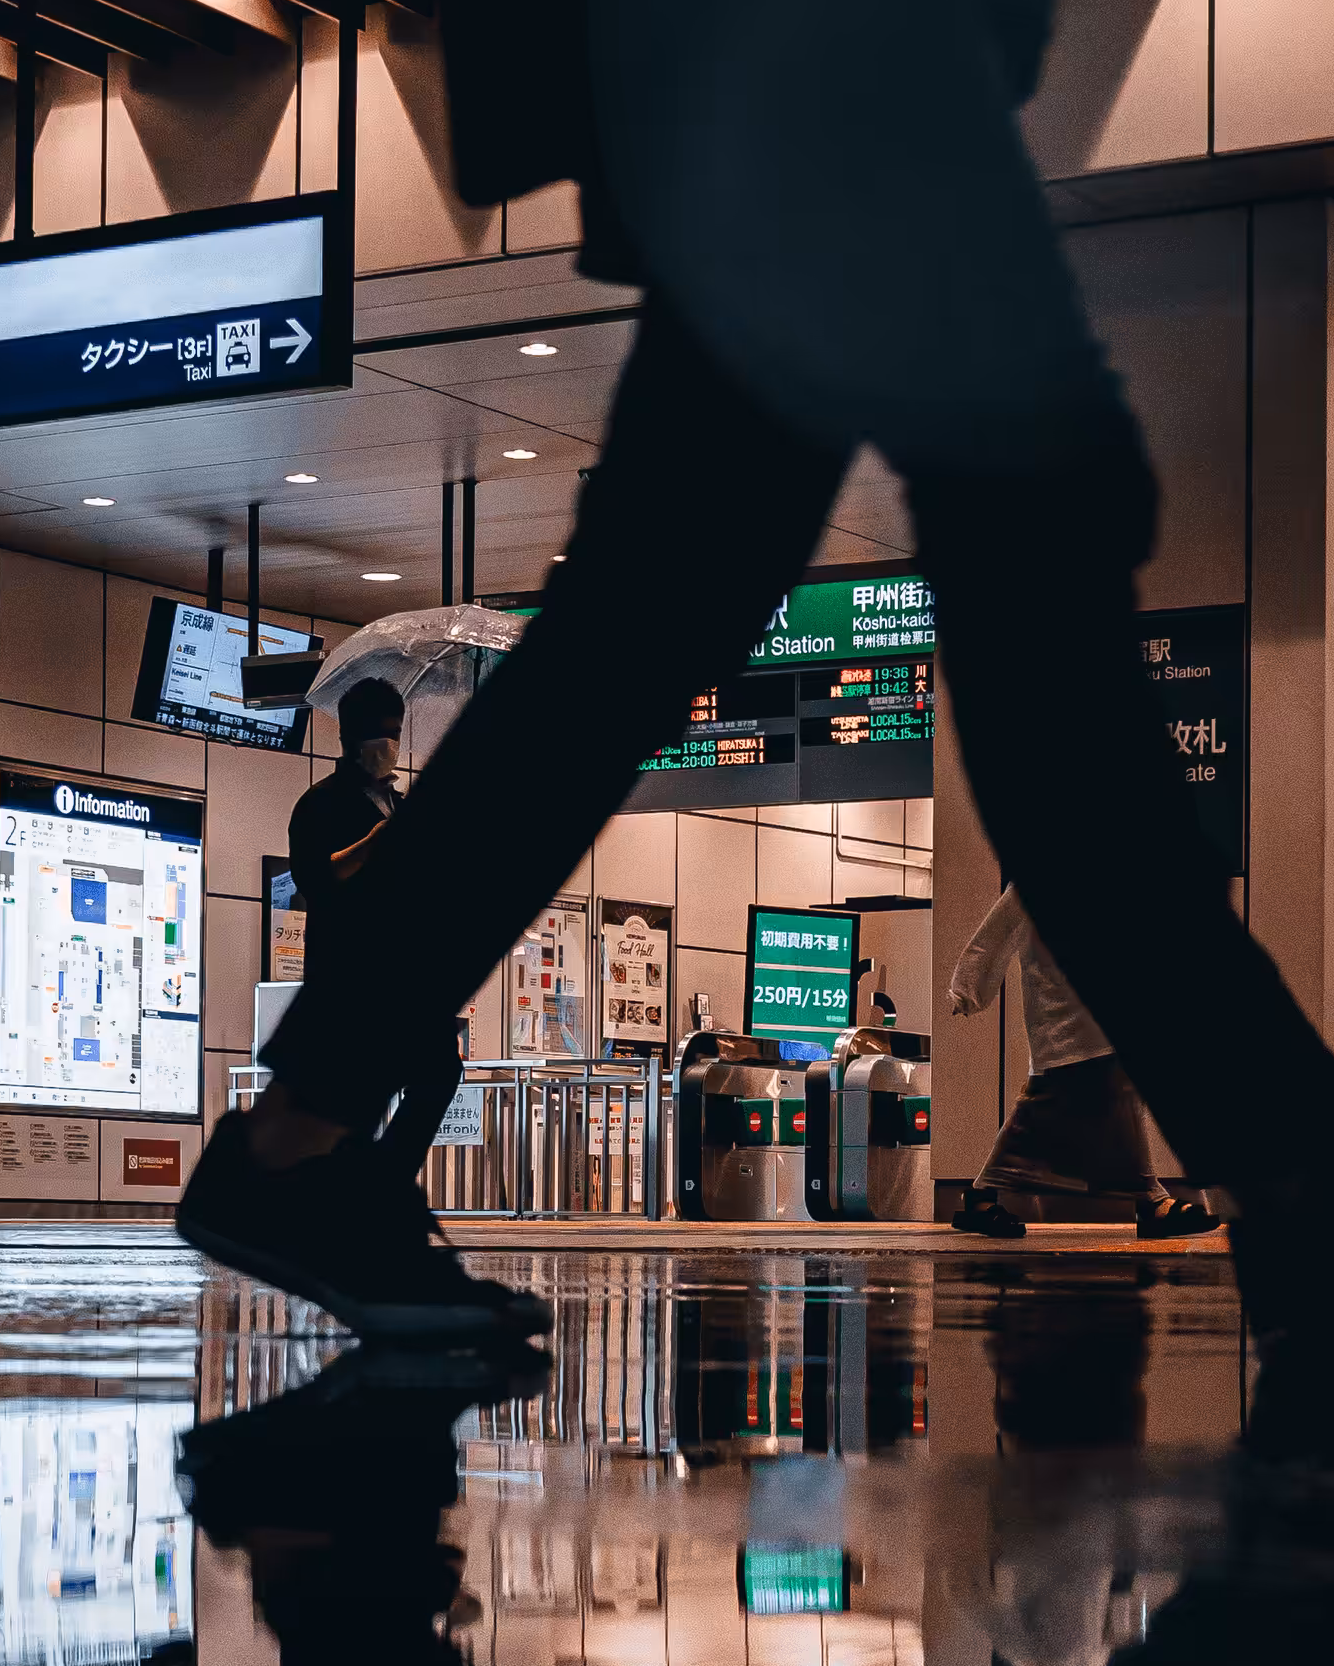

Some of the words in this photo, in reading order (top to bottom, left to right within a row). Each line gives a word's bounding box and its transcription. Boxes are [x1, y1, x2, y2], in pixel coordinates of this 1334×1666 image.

[221, 323, 256, 338] TAXI
[80, 337, 173, 372] タクシー
[183, 362, 212, 382] Taxi
[180, 611, 215, 633] 京成線
[771, 635, 834, 656] Station
[171, 666, 189, 679] Keisei
[189, 670, 203, 682] Line
[874, 667, 909, 680] 19:36
[1165, 666, 1211, 680] Station
[874, 681, 909, 695] 19:42
[915, 679, 926, 693] 大
[711, 694, 717, 706] 1
[711, 709, 717, 720] 1
[683, 741, 716, 754] 19:45
[717, 738, 757, 751] HIRATSUKA
[759, 737, 764, 749] 1
[682, 755, 716, 768] 20:00
[718, 752, 755, 765] ZUSHI
[759, 751, 764, 763] 1
[74, 791, 150, 823] Information
[617, 940, 634, 954] Food
[635, 943, 655, 958] Hall
[754, 986, 848, 1008] 250円/15分
